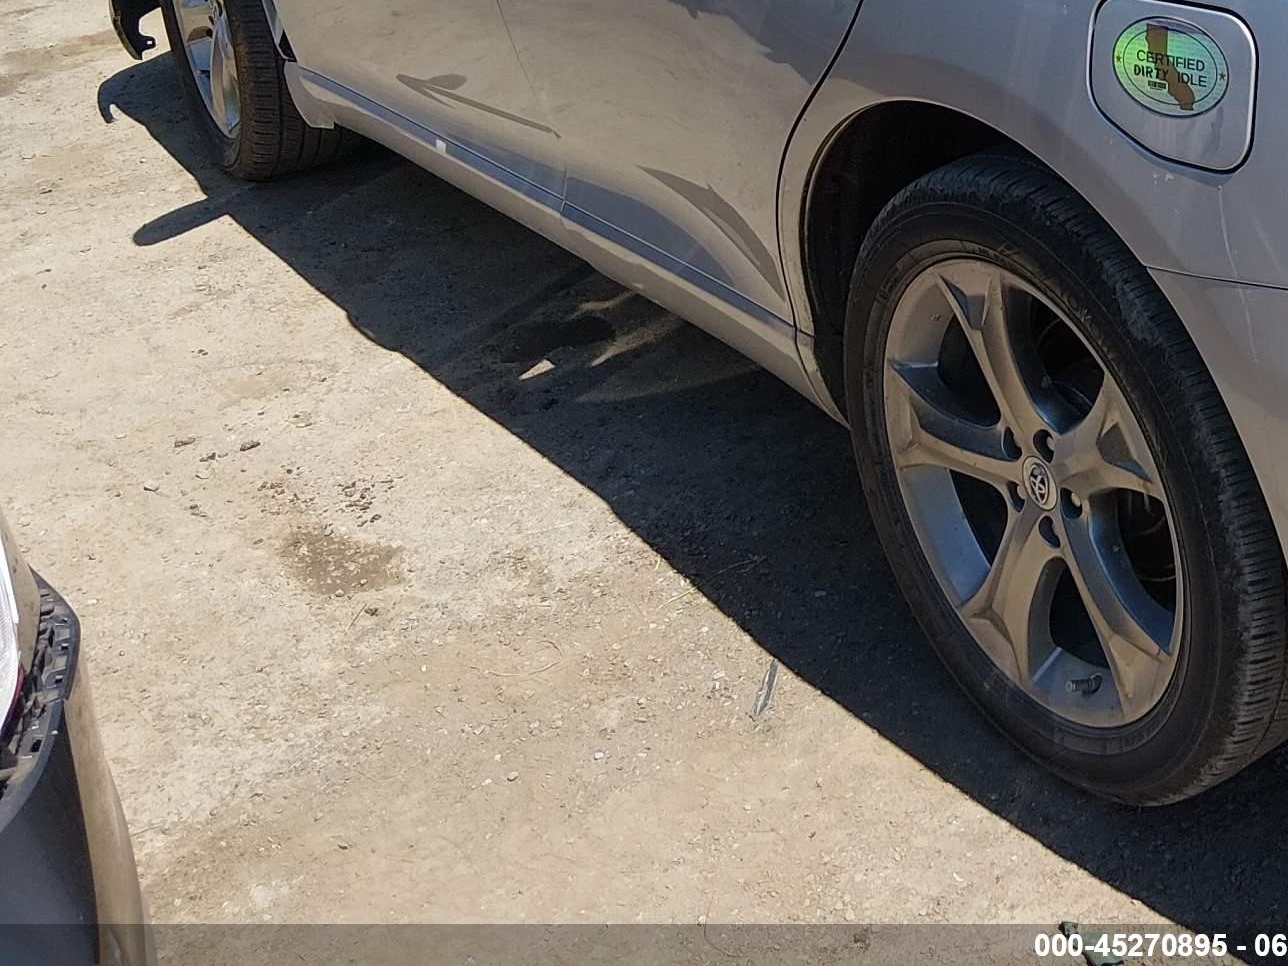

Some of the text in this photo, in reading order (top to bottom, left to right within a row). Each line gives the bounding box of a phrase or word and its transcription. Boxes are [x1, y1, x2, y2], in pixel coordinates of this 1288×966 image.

[1136, 49, 1205, 71] CERTIFIED
[1133, 64, 1168, 81] DIRTY
[1178, 72, 1207, 88] IDLE
